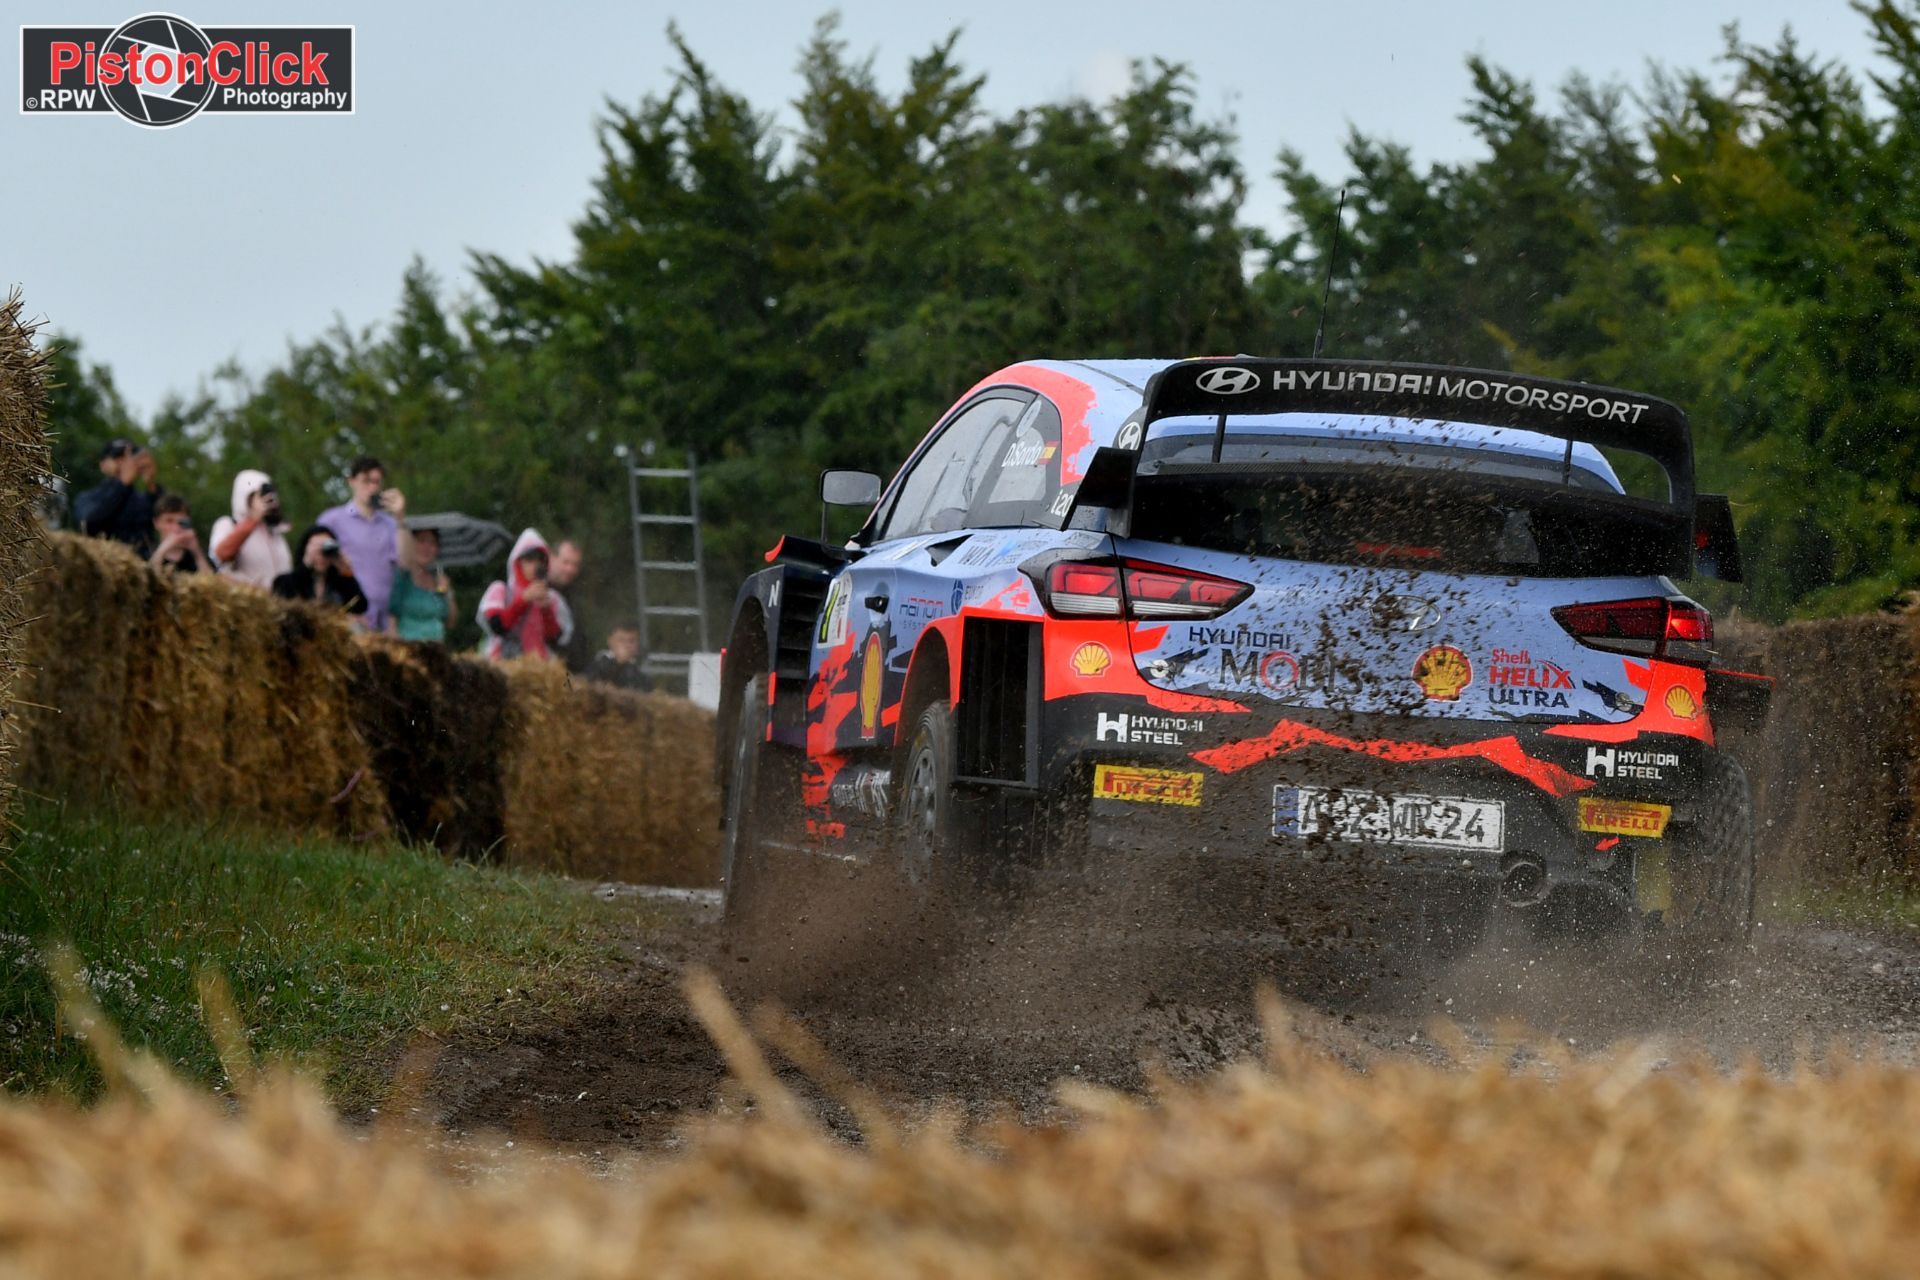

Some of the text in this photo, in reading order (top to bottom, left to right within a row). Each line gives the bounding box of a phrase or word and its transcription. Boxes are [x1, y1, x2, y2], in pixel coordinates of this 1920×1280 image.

[1272, 369, 1649, 425] HYUNDAI MOTORSPORT
[1189, 626, 1291, 650] HYUNDAI
[1491, 647, 1530, 665] Shell
[1488, 663, 1574, 690] HELIX
[1488, 687, 1570, 709] ULTRA
[1131, 714, 1204, 733] HYUNDAI
[1130, 730, 1184, 746] STEEL
[1617, 750, 1680, 767] HYUNDAI
[1617, 764, 1664, 780] STEEL
[1440, 803, 1486, 844] 24
[1585, 803, 1663, 832] PIRELLI
